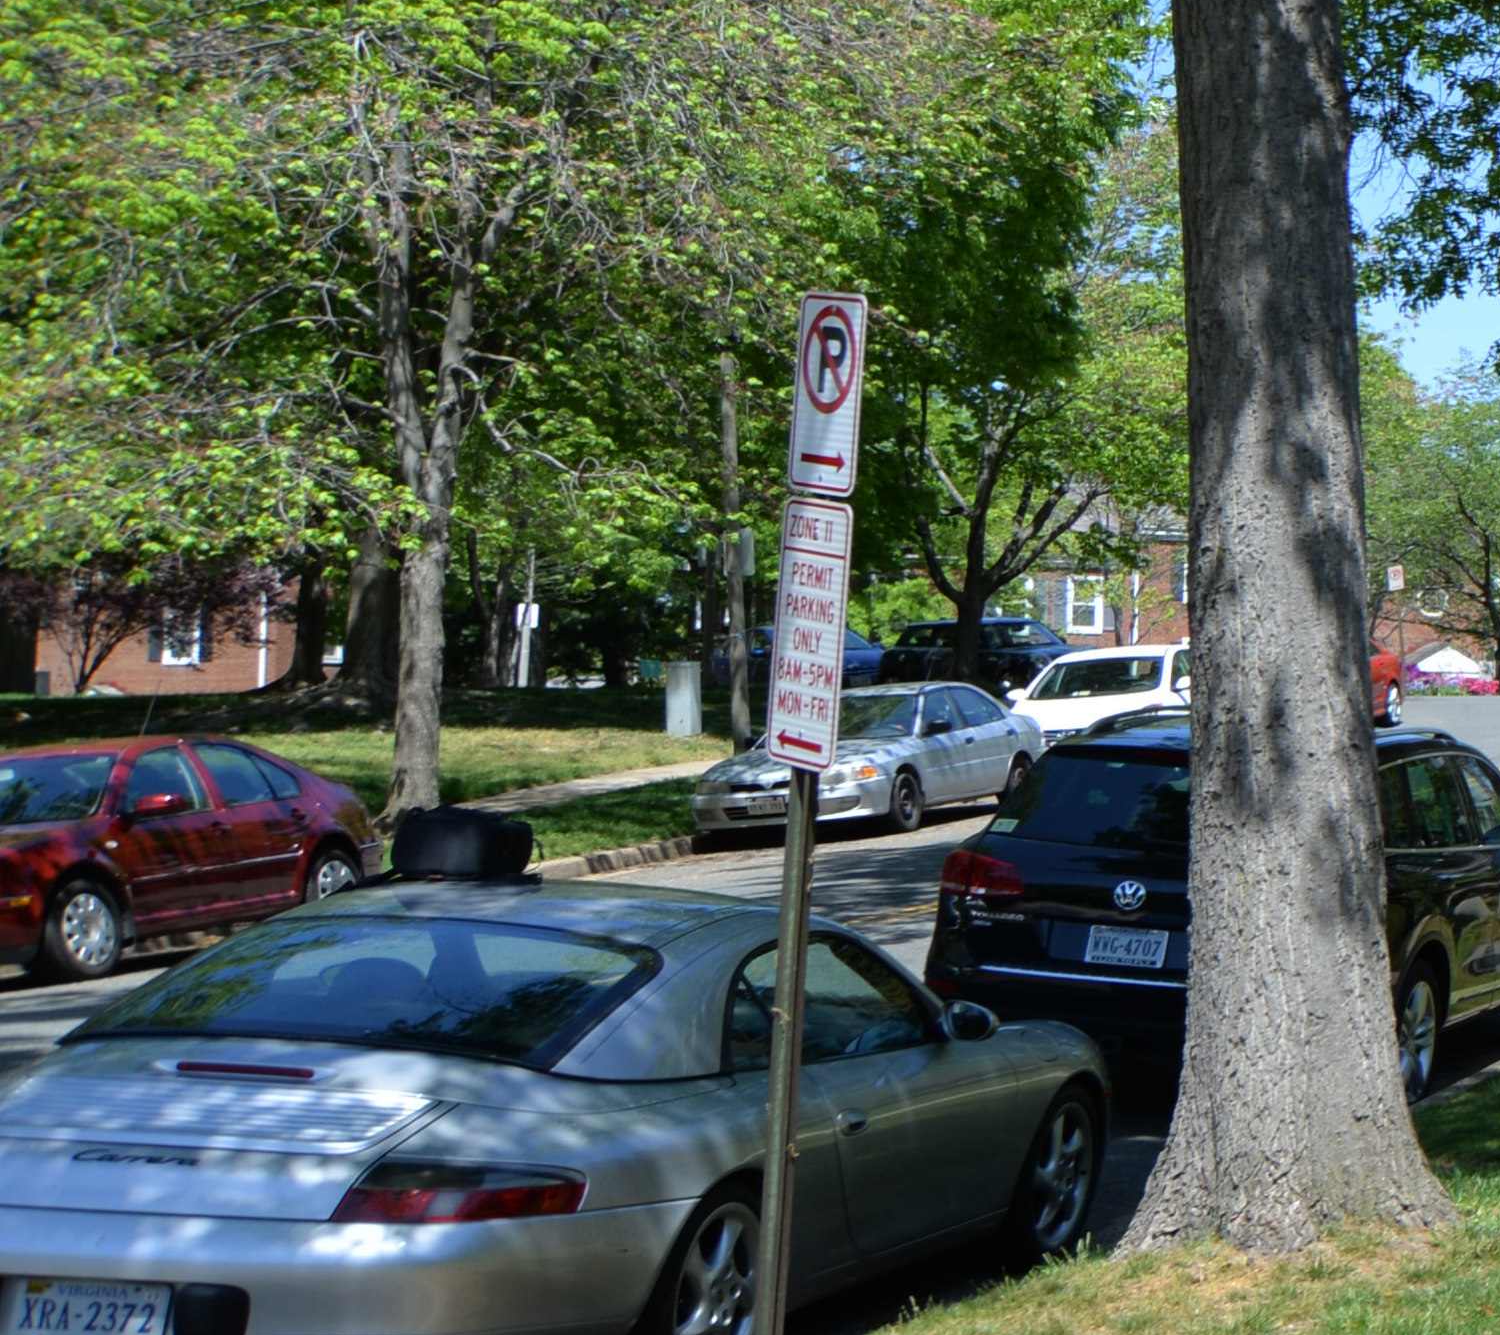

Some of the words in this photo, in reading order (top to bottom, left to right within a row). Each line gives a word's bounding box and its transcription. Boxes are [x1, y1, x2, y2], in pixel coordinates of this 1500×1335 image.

[790, 515, 819, 541] ZONE
[825, 520, 834, 543] 11
[792, 562, 834, 591] PERMIT
[786, 593, 834, 624] PARKING
[793, 627, 822, 653] ONLY
[777, 657, 834, 689] 8AM-5PM
[777, 689, 828, 722] MON-FRI
[72, 1148, 201, 1166] Carrera
[57, 1283, 129, 1299] VIRGINIA
[18, 1297, 156, 1334] XRA-2372
